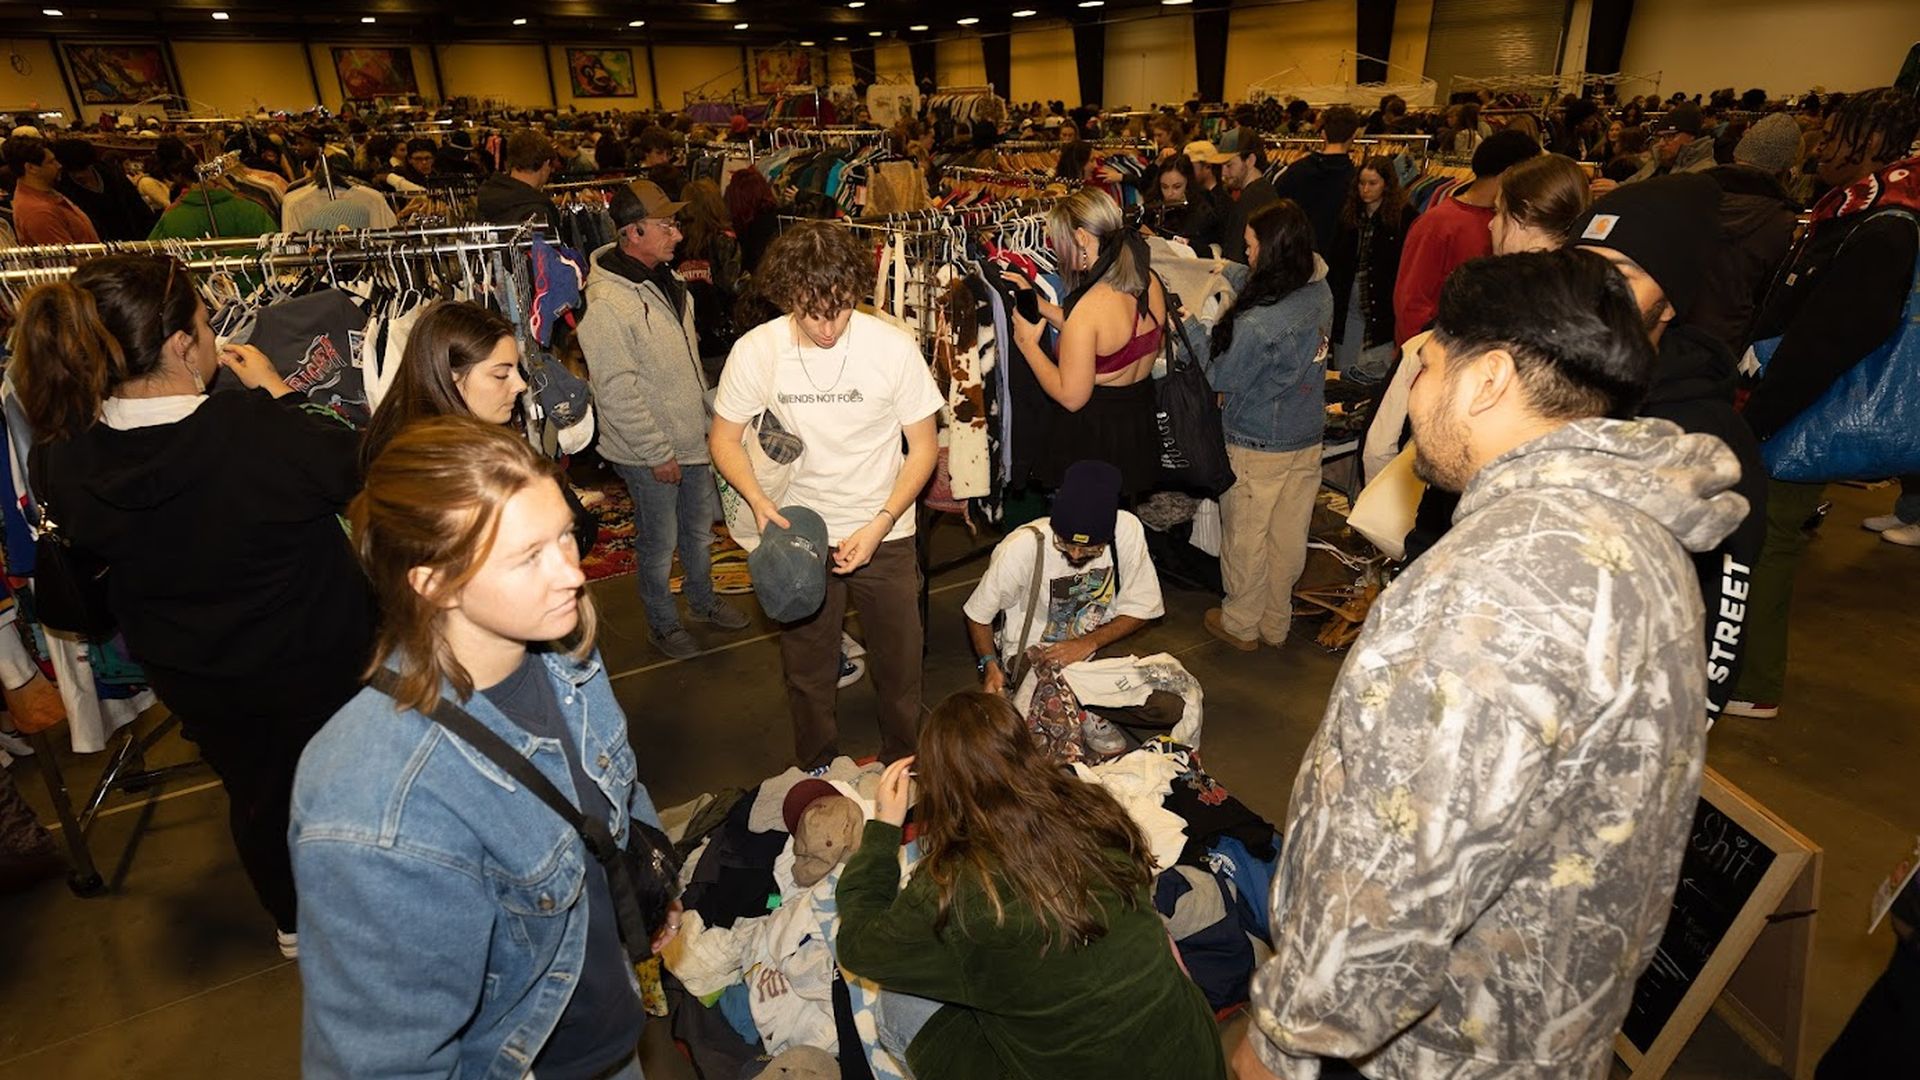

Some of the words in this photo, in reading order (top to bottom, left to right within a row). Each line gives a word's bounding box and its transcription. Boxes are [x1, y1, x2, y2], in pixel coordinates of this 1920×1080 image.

[816, 393, 836, 403] NOT
[1707, 553, 1750, 684] STREET
[1693, 812, 1759, 880] Shit
